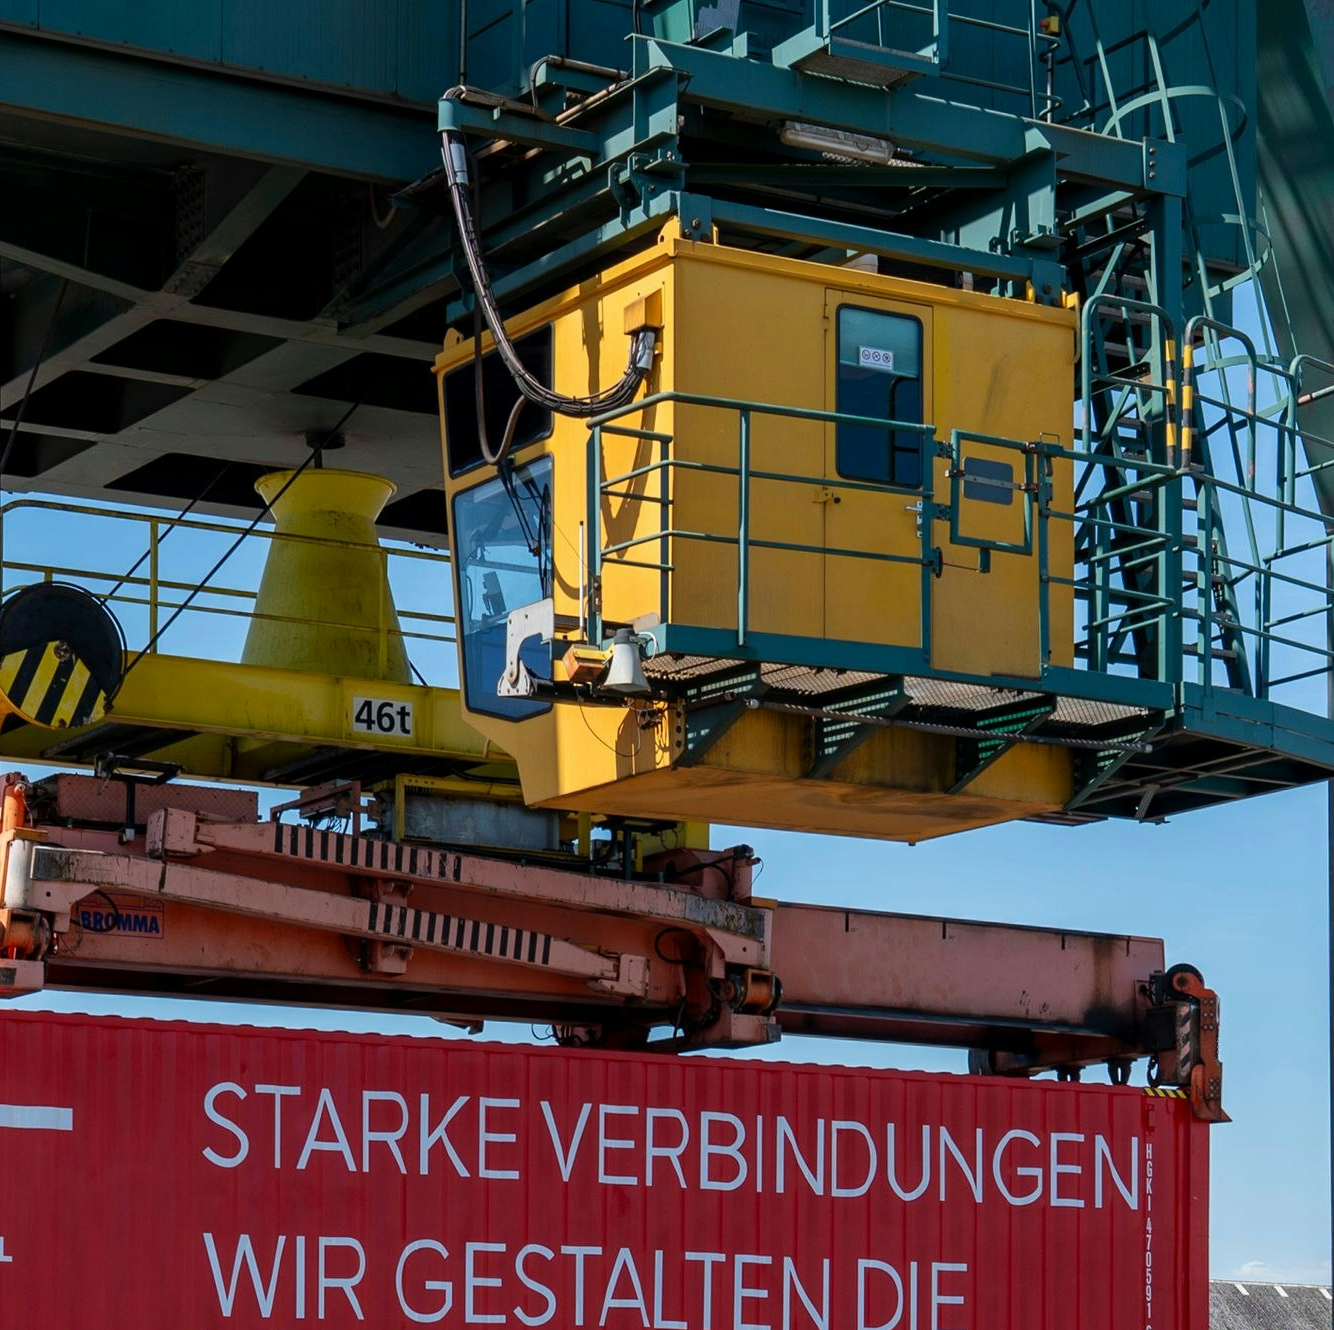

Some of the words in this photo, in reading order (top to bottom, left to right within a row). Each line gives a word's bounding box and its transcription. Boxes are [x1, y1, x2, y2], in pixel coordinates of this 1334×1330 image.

[355, 700, 411, 734] 46t
[81, 911, 159, 933] BROMMA
[202, 1082, 520, 1179] STARKE
[540, 1101, 1138, 1210] VERBINDUNGEN
[203, 1232, 366, 1320] WIR
